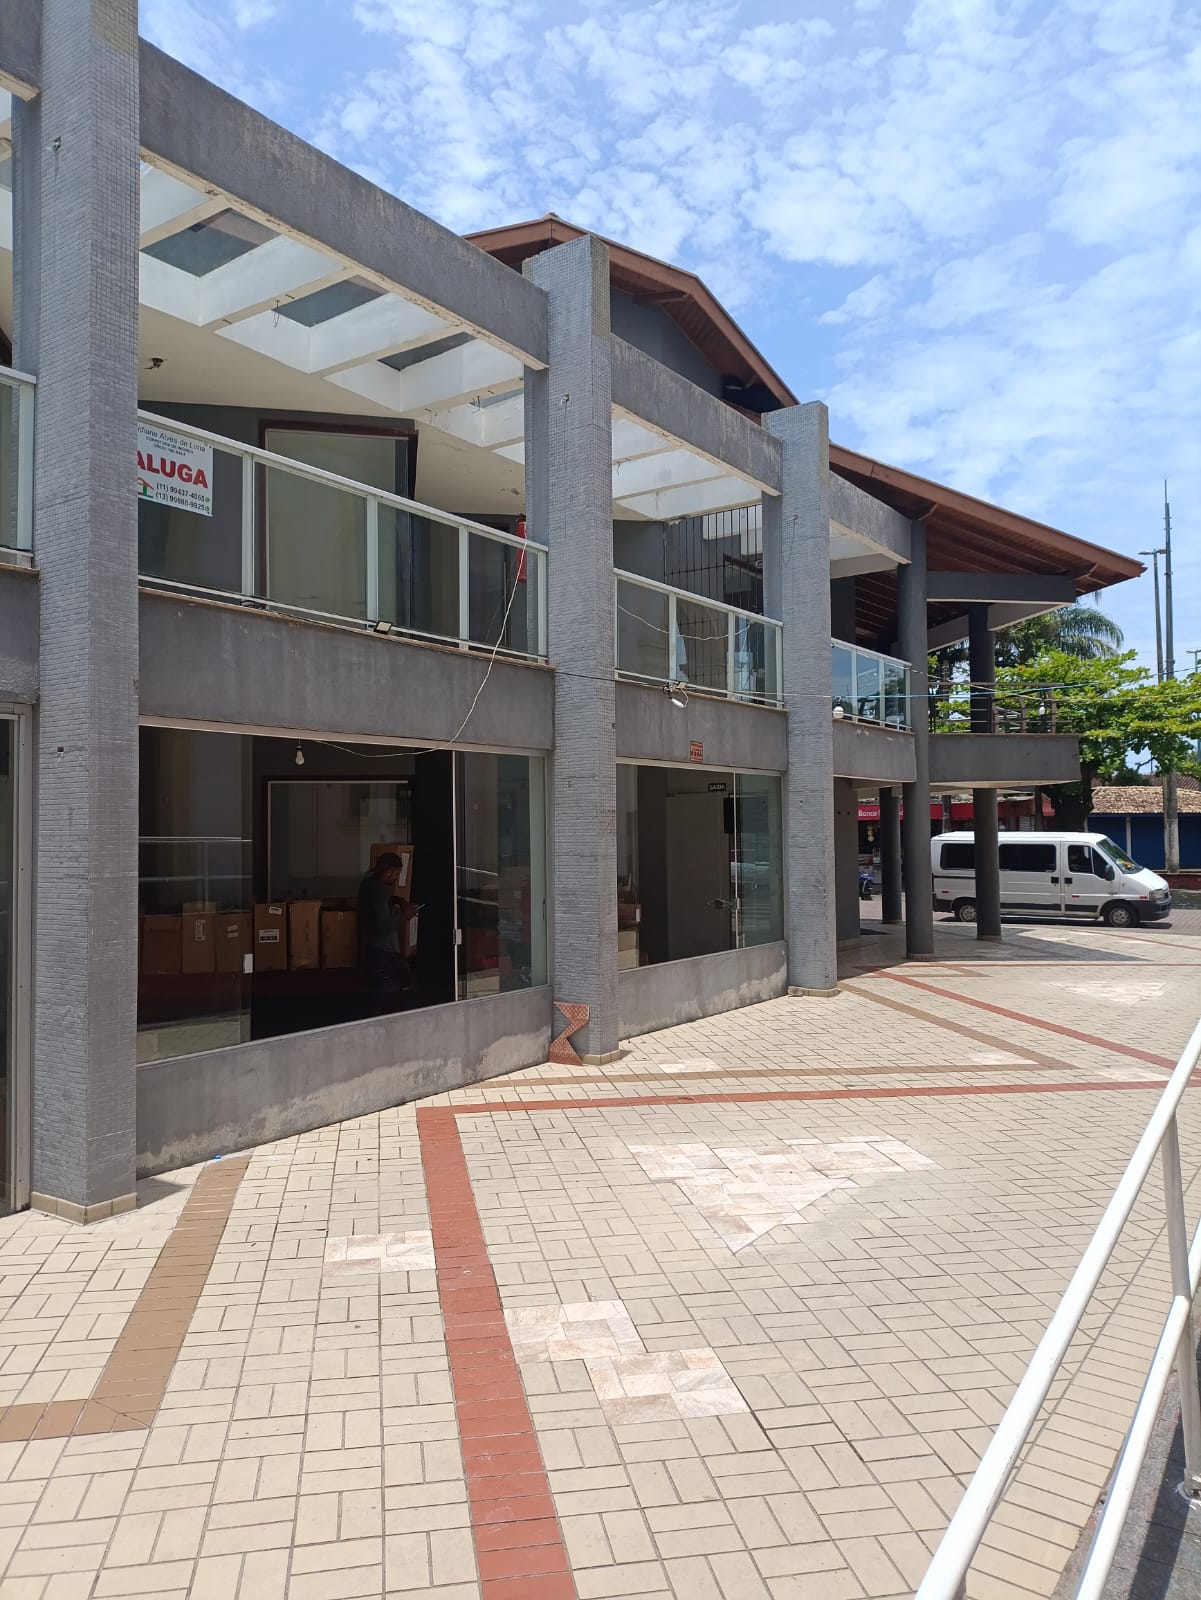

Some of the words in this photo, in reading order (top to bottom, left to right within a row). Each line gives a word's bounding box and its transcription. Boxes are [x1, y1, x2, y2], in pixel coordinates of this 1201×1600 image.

[160, 431, 177, 444] Alves
[179, 439, 188, 447] de
[189, 441, 206, 451] Lima
